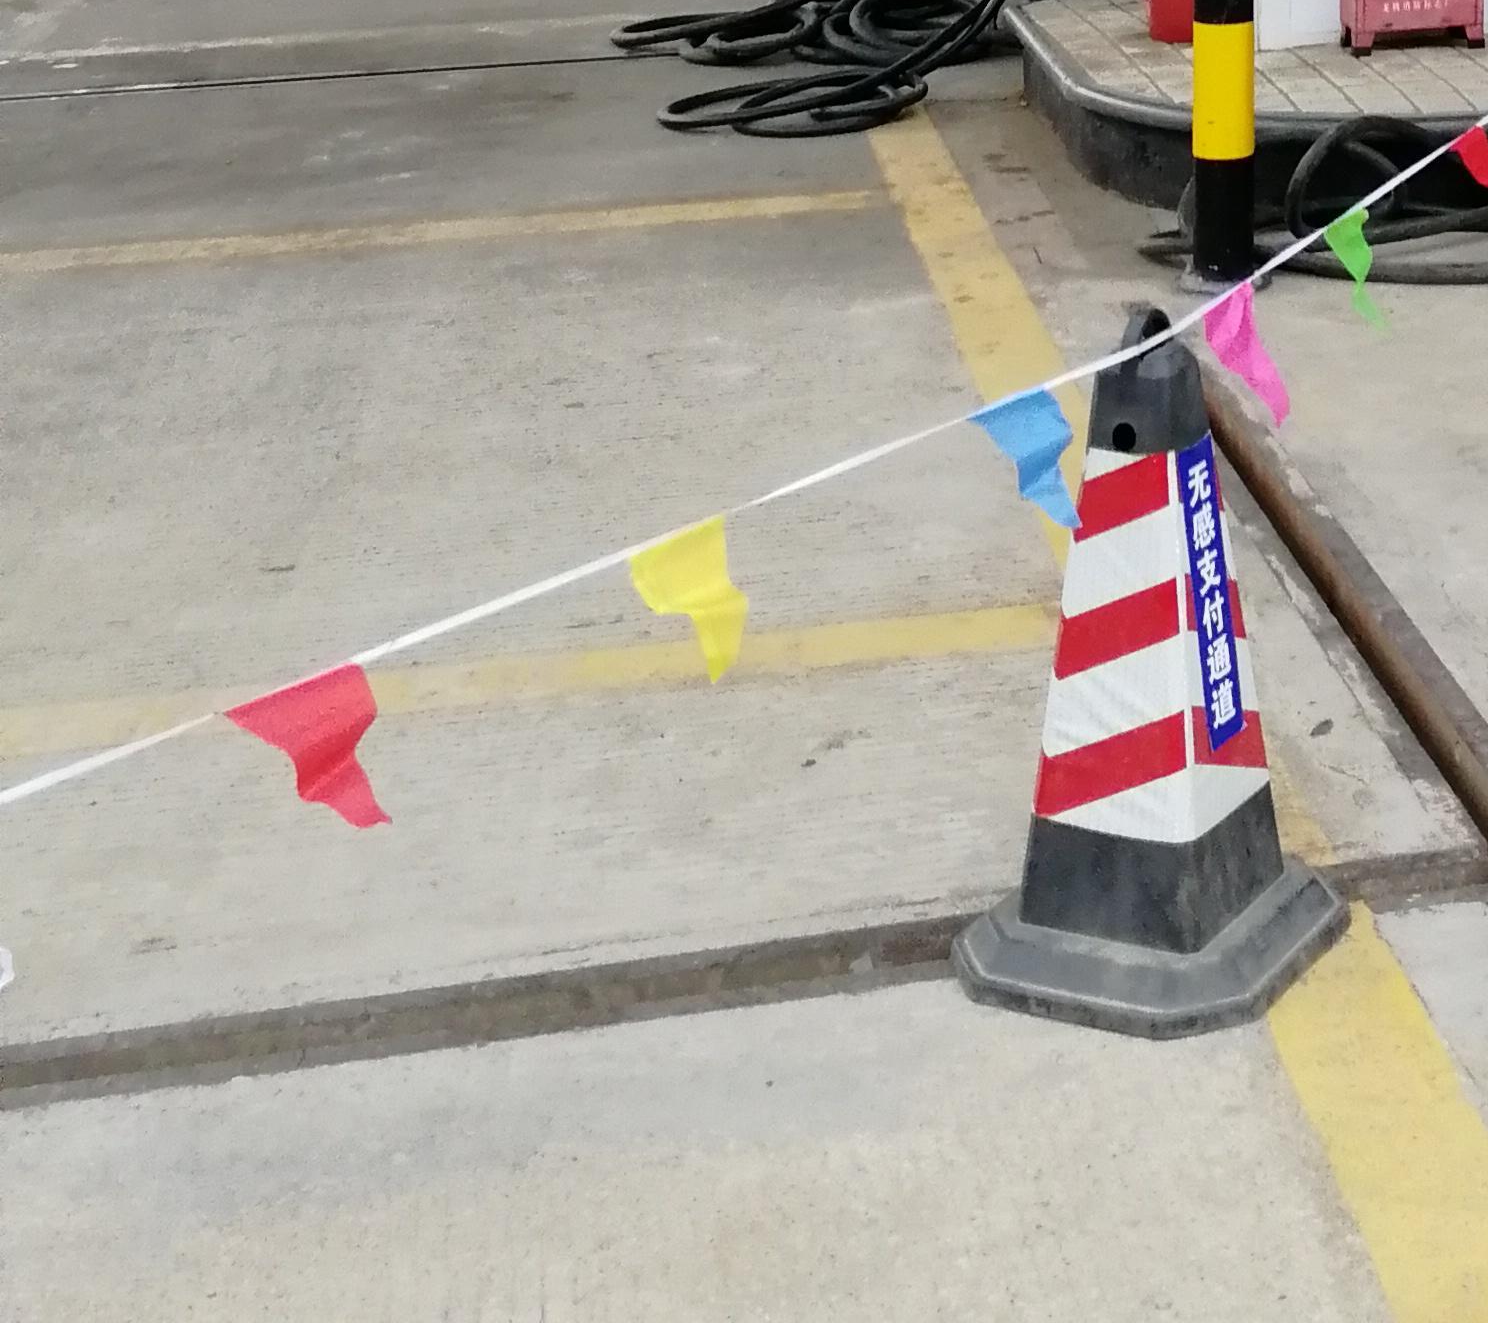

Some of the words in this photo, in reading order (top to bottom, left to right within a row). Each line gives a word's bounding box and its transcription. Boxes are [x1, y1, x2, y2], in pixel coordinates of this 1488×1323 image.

[1187, 458, 1237, 731] 无感支付通道
